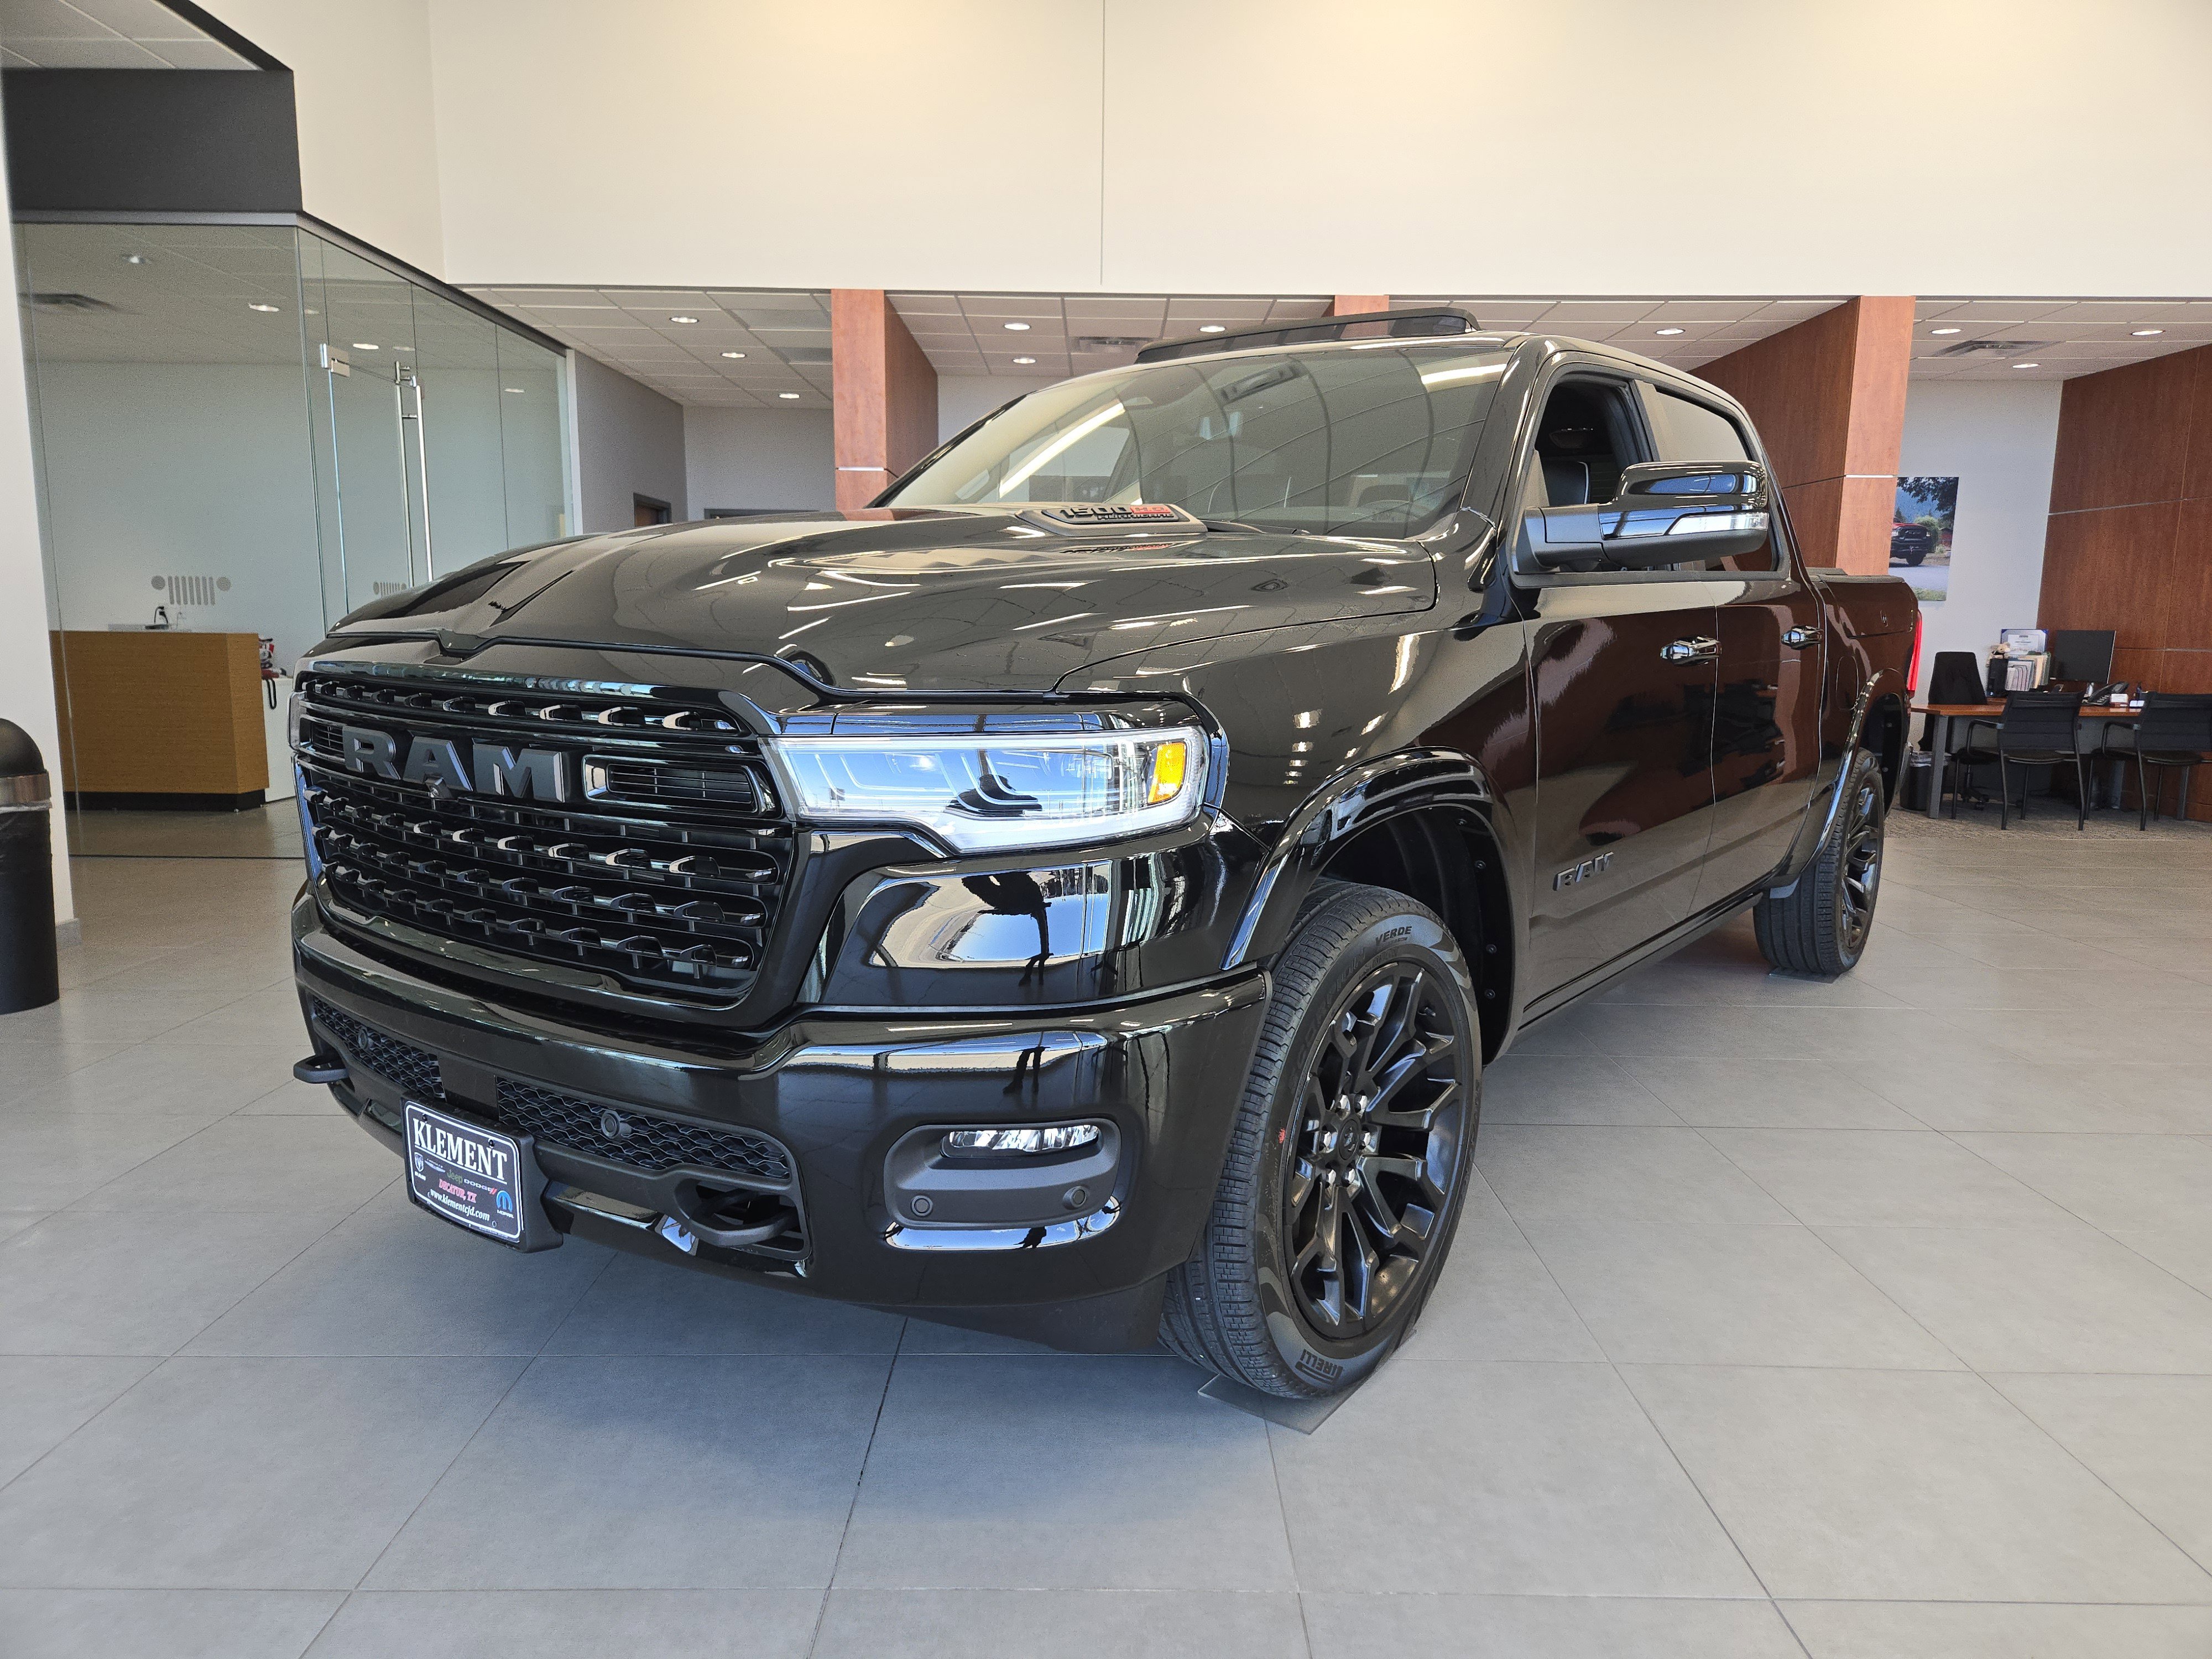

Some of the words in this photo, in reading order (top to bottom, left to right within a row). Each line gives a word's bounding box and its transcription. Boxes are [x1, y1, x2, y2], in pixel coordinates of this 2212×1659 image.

[1060, 507, 1132, 519] 1500
[342, 725, 566, 803] RAM
[1553, 851, 1614, 891] RAM
[1375, 925, 1412, 946] VERDE
[413, 1118, 508, 1180] KLEMENT
[447, 1168, 463, 1184] Jeep
[464, 1178, 492, 1192] DODGE
[430, 1189, 490, 1221] www.klementcjd.com
[467, 1191, 477, 1203] TX
[1295, 1349, 1344, 1385] PIRELLI
